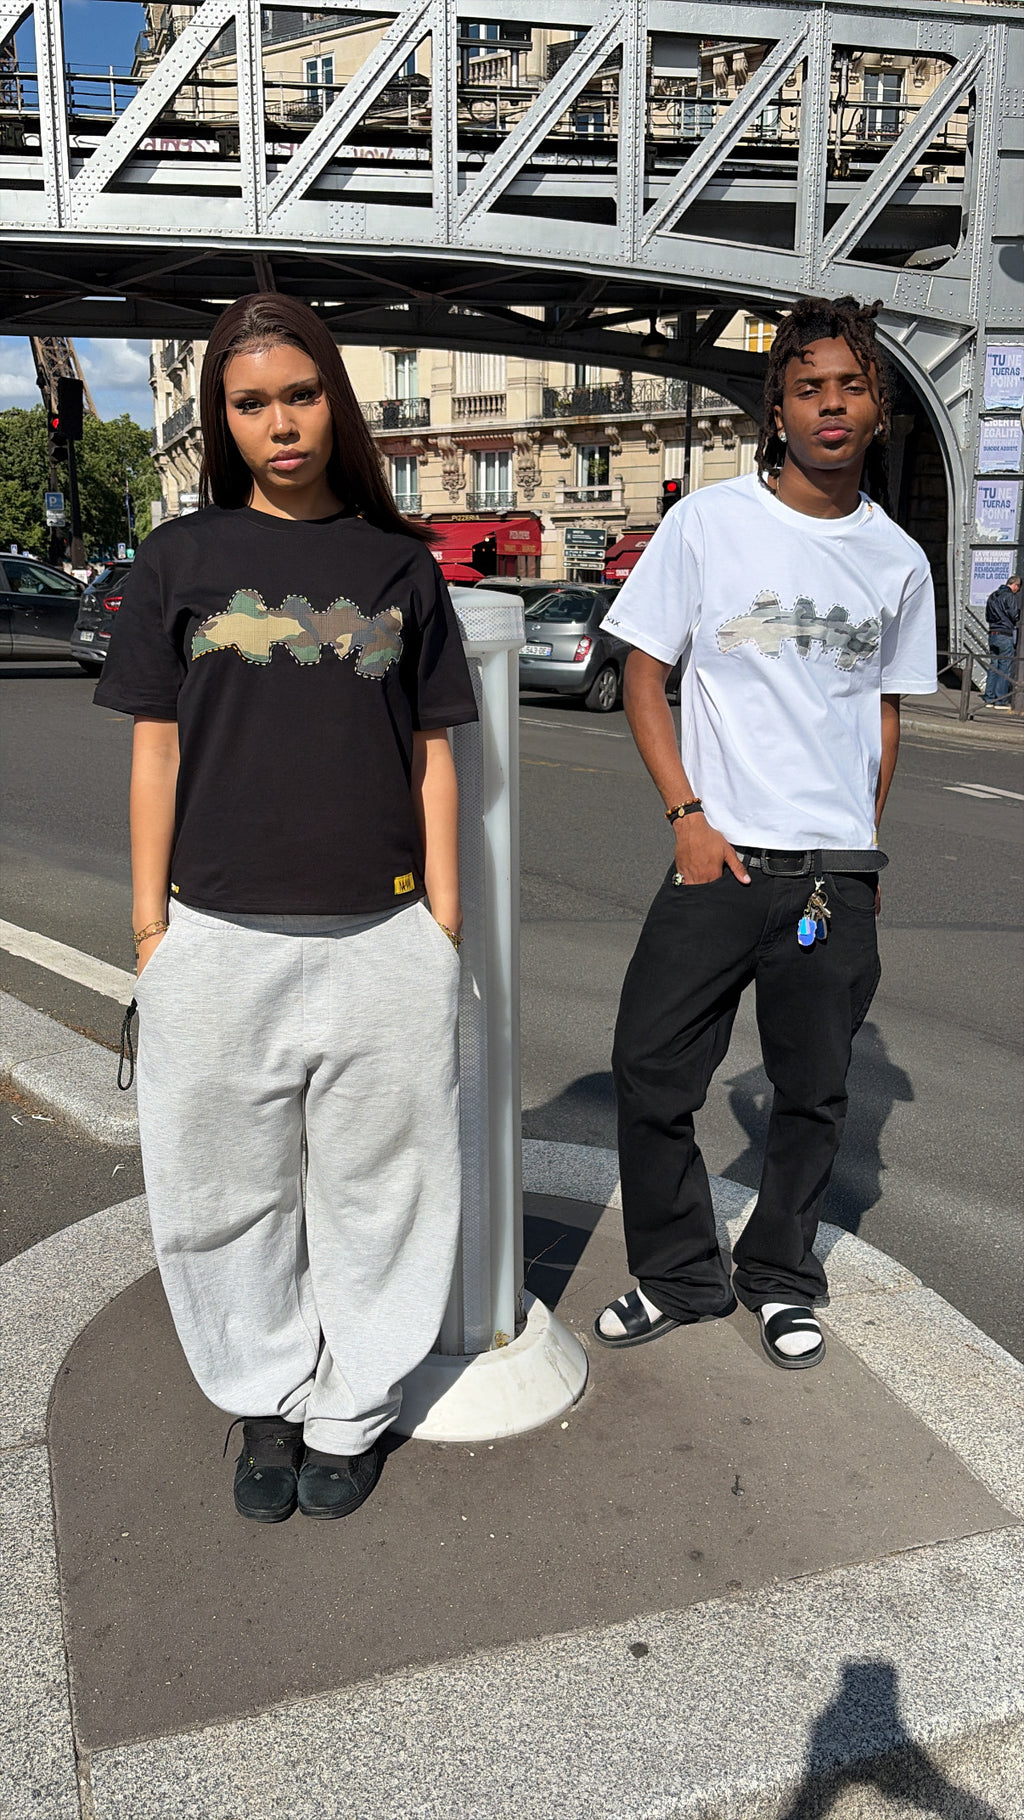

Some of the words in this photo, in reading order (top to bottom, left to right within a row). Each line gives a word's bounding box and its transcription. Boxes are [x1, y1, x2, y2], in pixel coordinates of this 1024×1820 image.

[1008, 355, 1021, 367] NE
[992, 367, 1020, 376] TUERAS
[998, 488, 1012, 499] NE
[49, 496, 57, 507] P
[983, 500, 1011, 508] TUERAS
